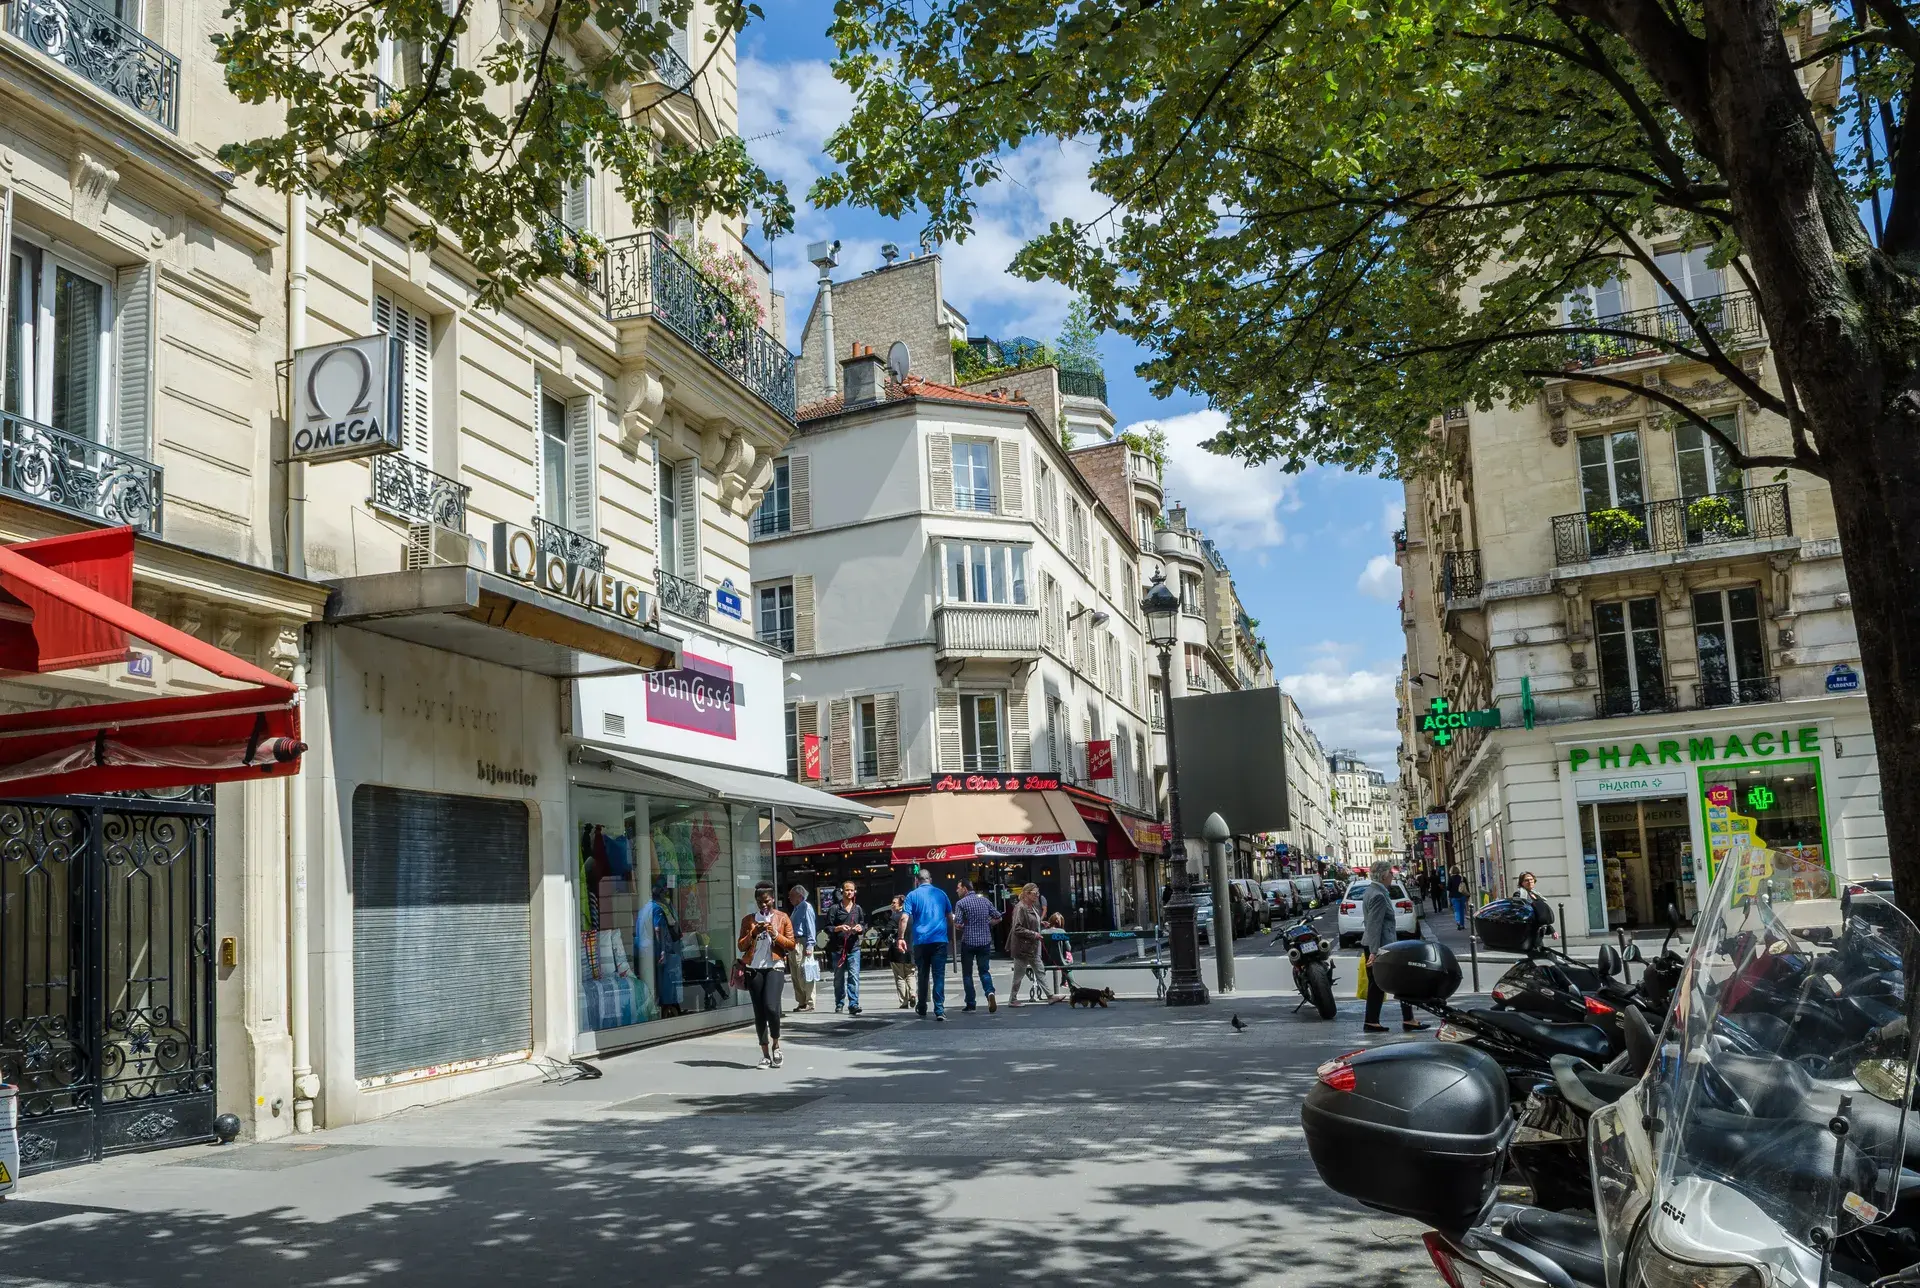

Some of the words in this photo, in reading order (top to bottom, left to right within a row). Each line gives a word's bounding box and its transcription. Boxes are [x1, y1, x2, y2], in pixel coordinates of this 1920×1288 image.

[294, 416, 383, 452] OMEGA
[547, 556, 661, 630] OMEGA
[1570, 727, 1821, 772] PHARMACIE
[477, 760, 538, 787] bijoutier
[936, 775, 962, 790] Au
[966, 776, 1001, 791] Clair
[1005, 778, 1020, 790] de
[1024, 775, 1058, 789] Lune
[1599, 780, 1649, 792] PHARMA
[1712, 791, 1728, 800] ICI
[841, 839, 861, 849] Service
[987, 843, 1024, 853] CHANGEMENT
[1034, 842, 1072, 853] DIRECTION
[927, 847, 947, 860] Café
[1661, 1201, 1686, 1225] GIVI
